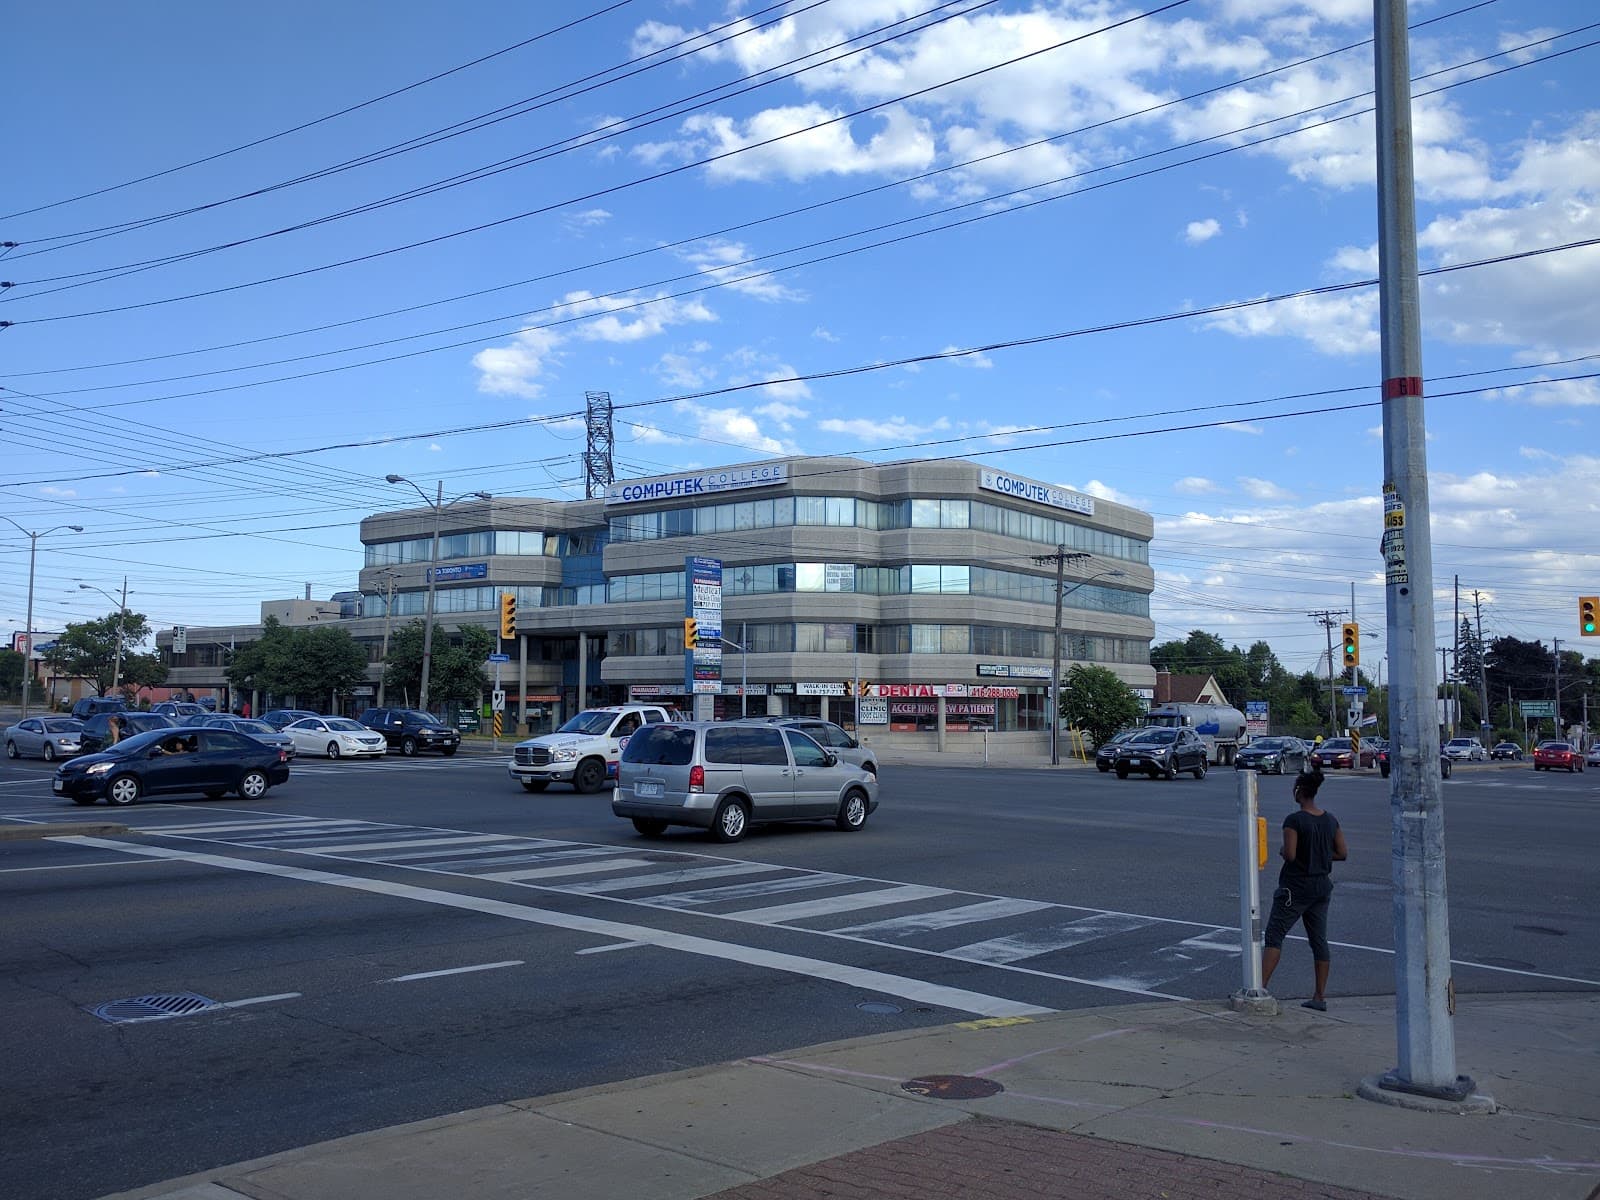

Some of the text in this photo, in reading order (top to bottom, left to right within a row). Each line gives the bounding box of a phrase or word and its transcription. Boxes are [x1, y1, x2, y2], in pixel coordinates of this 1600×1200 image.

[622, 478, 704, 501] COMPUTEK
[708, 466, 780, 485] COLLEGE
[996, 476, 1050, 503] COMPUTEK
[1052, 489, 1092, 508] COLLEGE
[693, 585, 721, 595] Medical
[879, 684, 938, 697] DENTAL
[971, 685, 1020, 699] 416-288-0333
[891, 703, 995, 714] ACCEPTING EW PATIENTS
